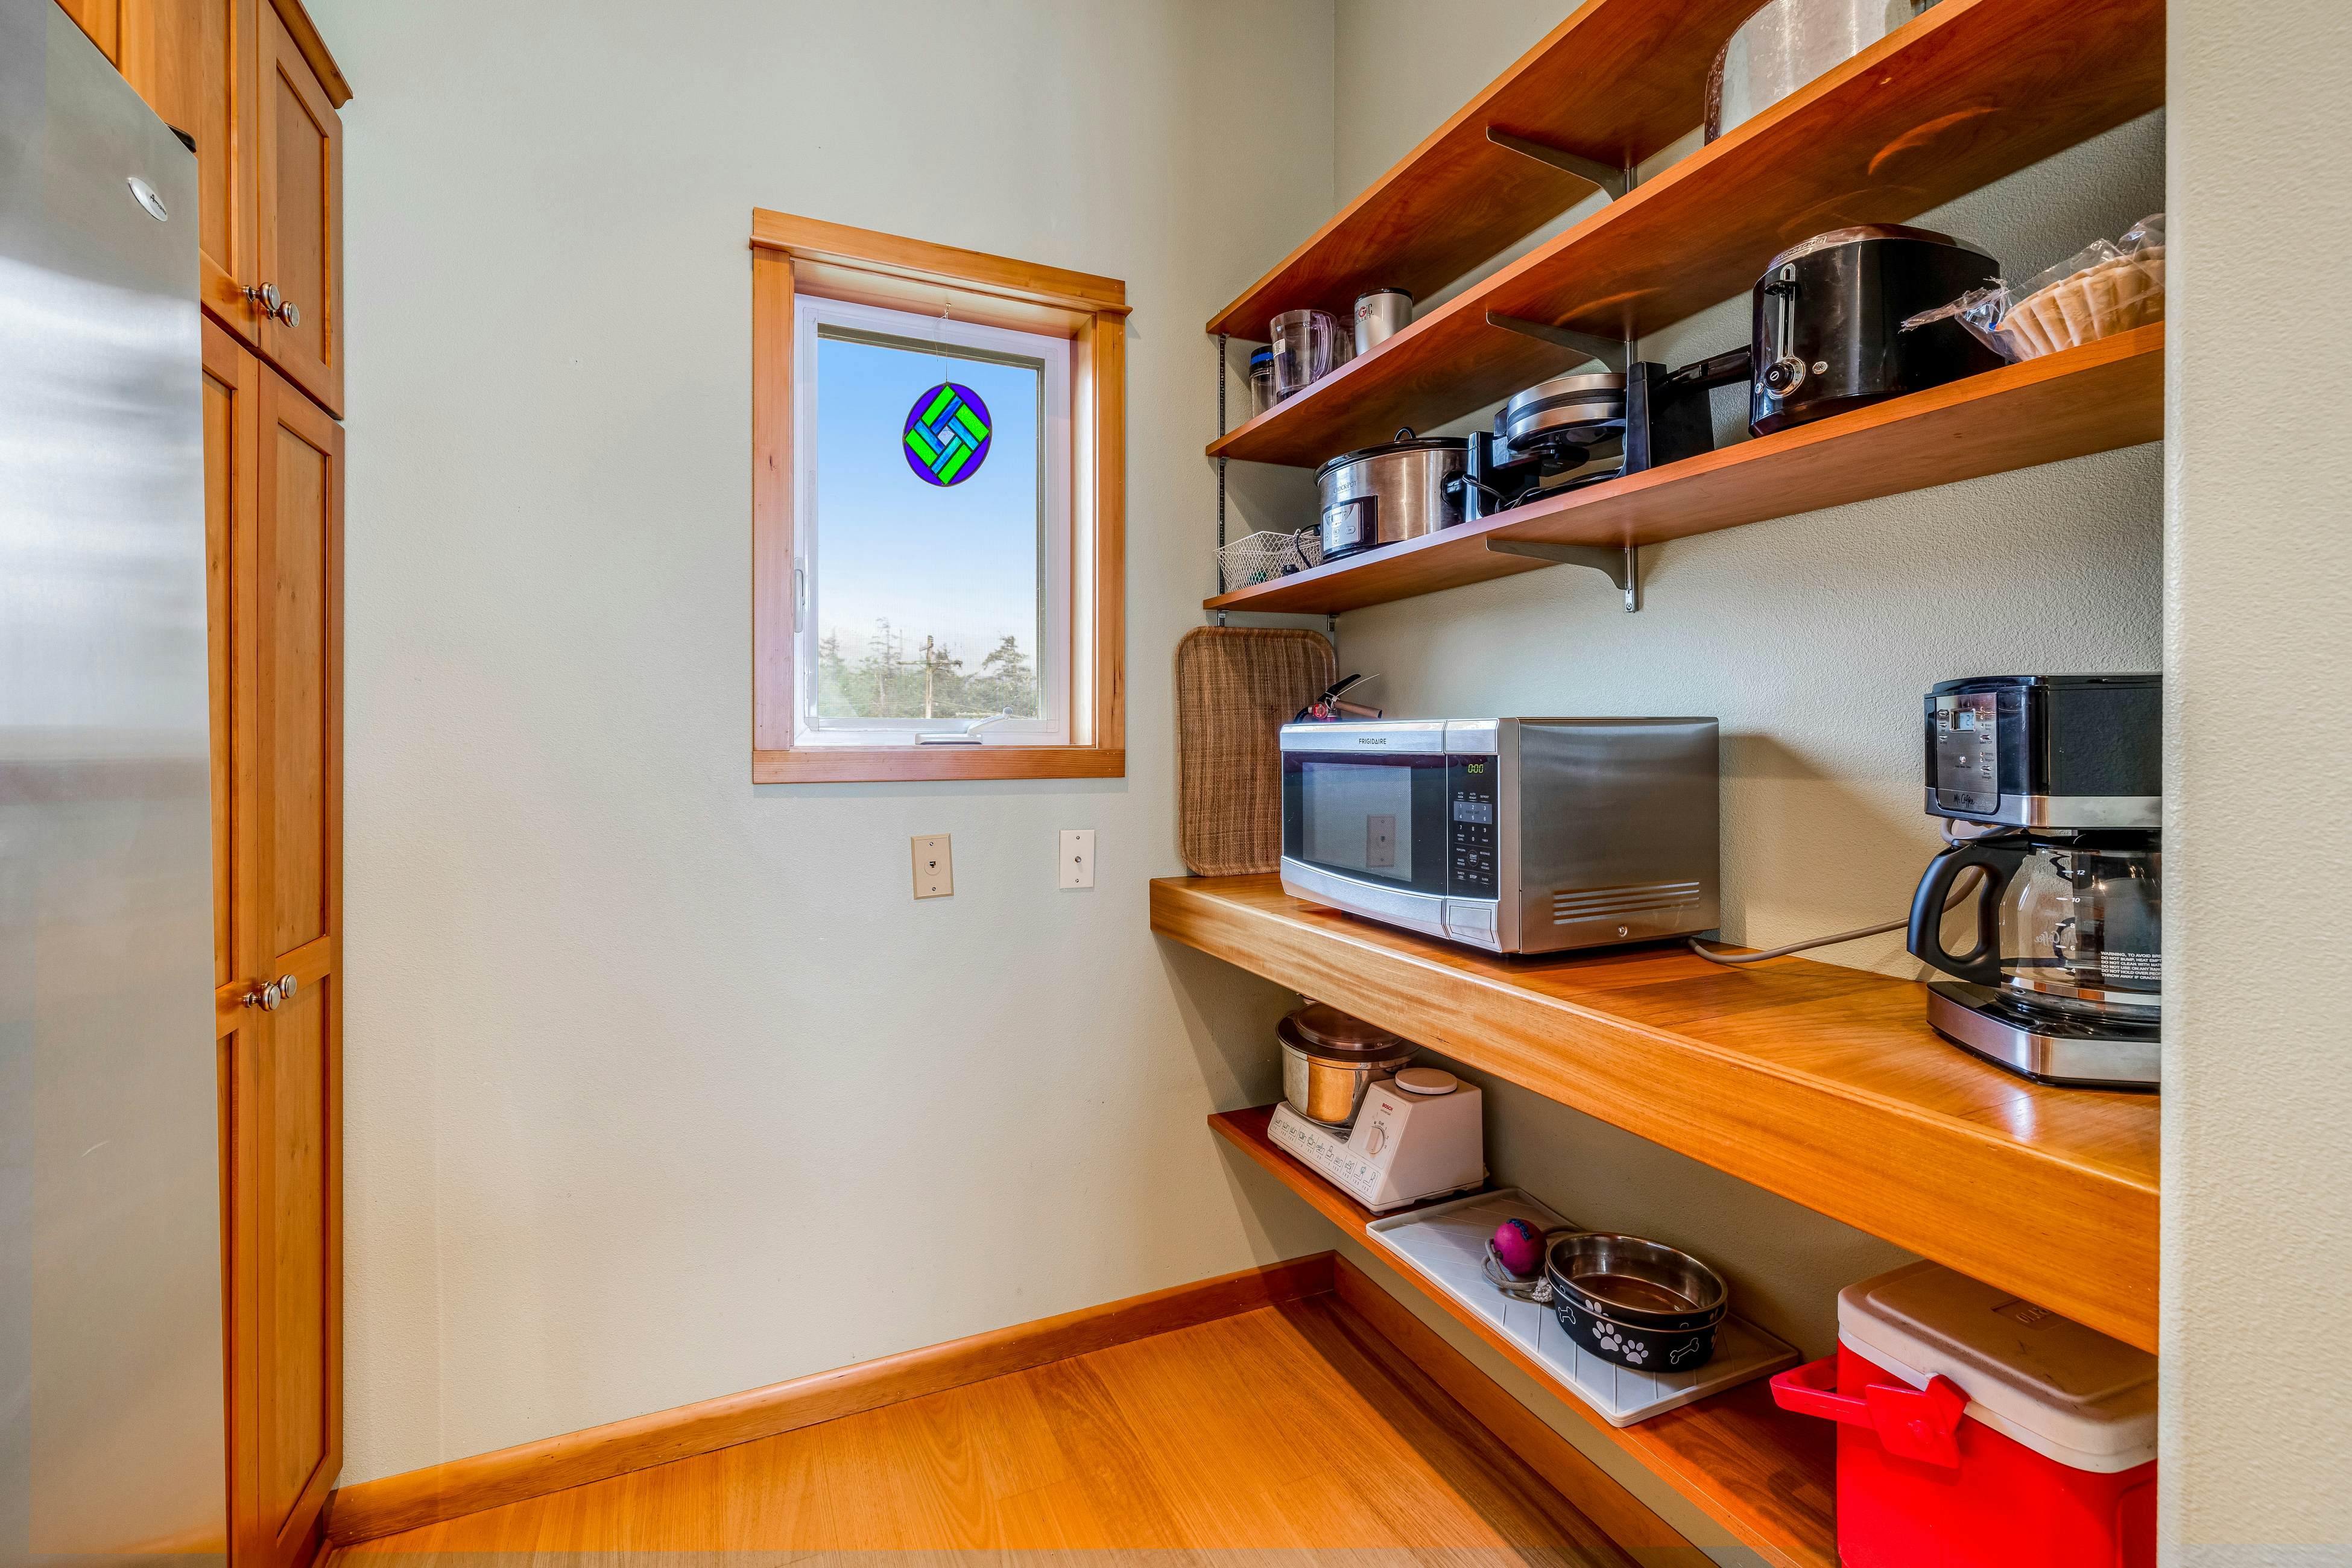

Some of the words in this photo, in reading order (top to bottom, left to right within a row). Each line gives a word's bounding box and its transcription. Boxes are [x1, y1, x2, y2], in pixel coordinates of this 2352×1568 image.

[1468, 763, 1484, 773] 0:00
[1961, 794, 1975, 808] Coffee
[1382, 1102, 1394, 1111] BOSCH
